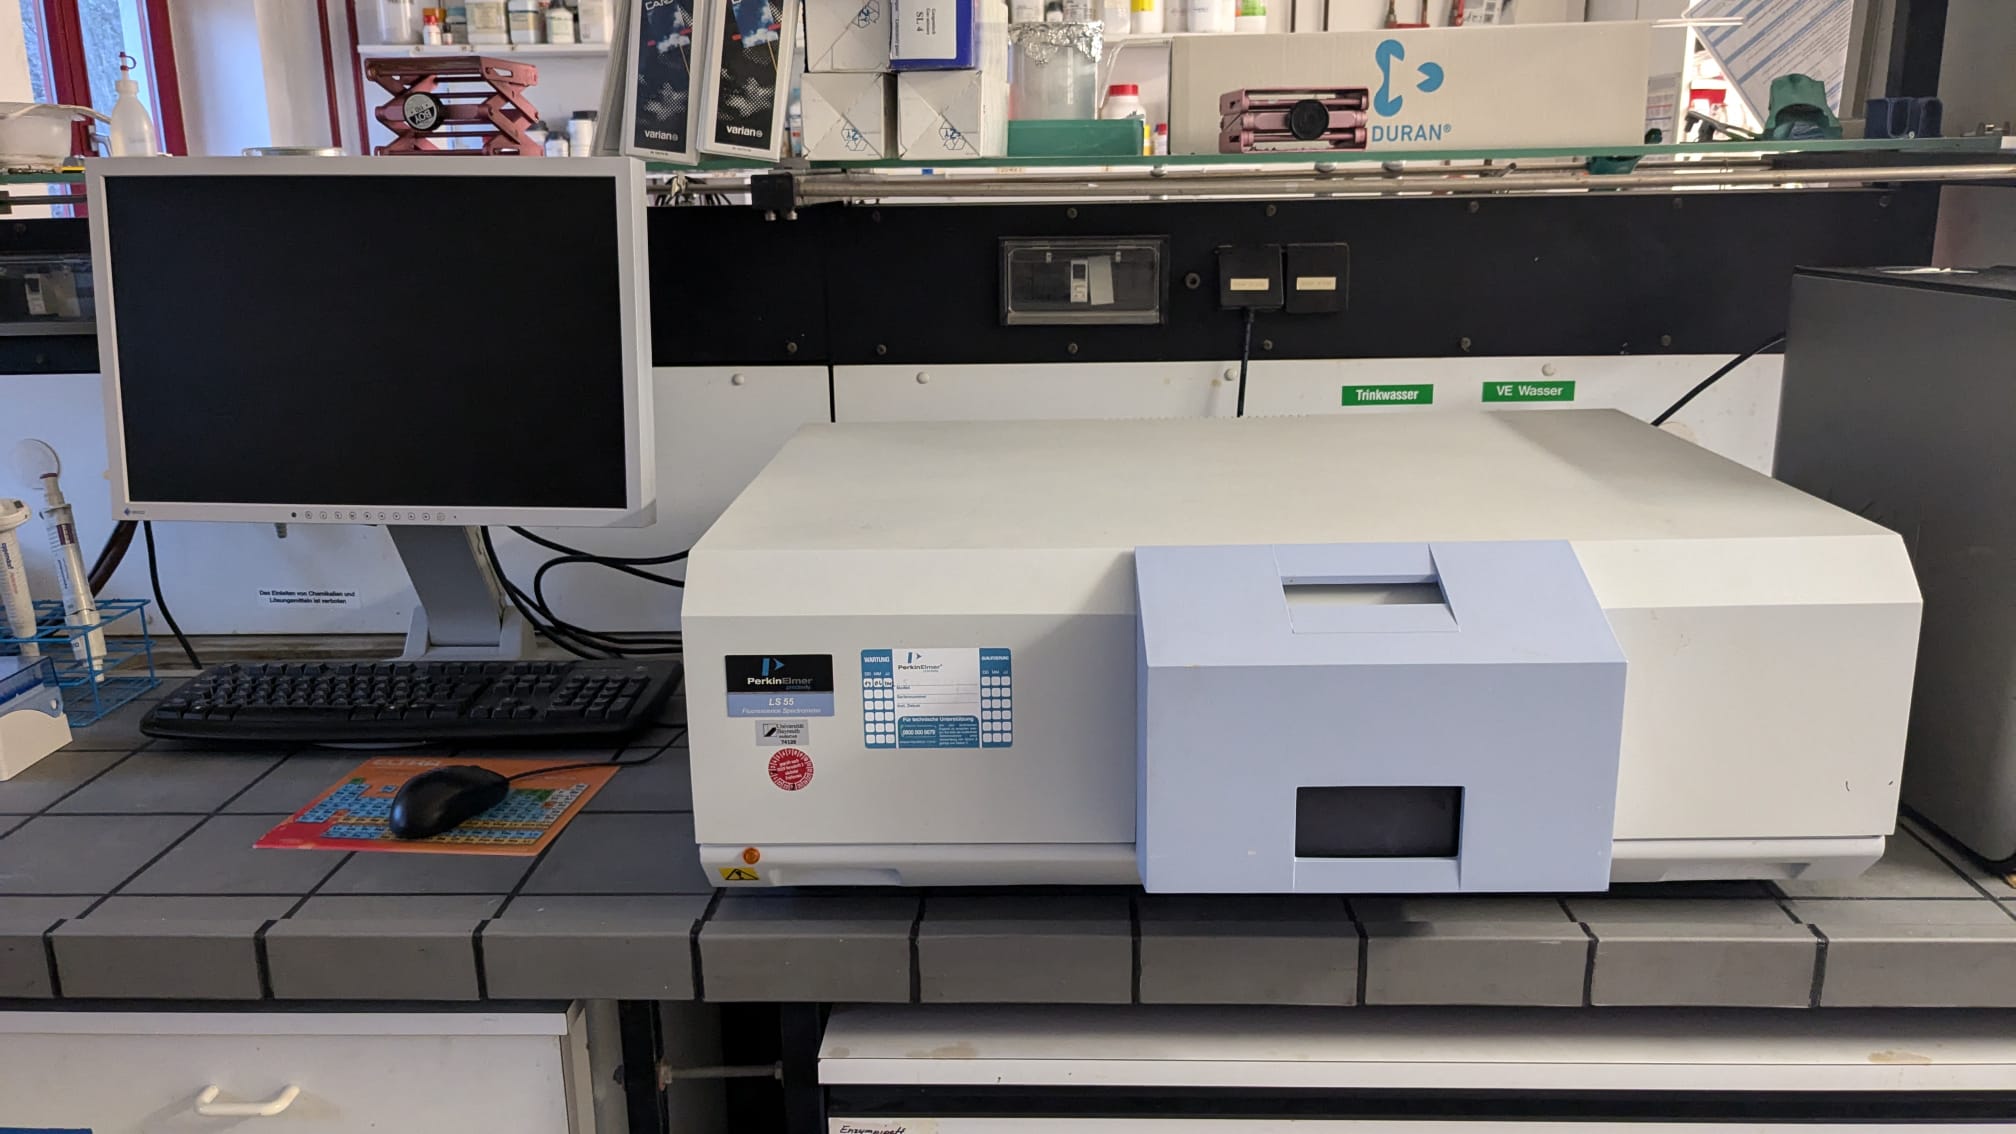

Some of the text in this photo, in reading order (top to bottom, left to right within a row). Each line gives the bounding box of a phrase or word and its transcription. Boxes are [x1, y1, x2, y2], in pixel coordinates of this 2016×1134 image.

[644, 130, 672, 141] varian
[726, 125, 756, 137] varian
[1355, 388, 1420, 401] Trinkwasser
[1496, 385, 1563, 397] VE Wasser
[746, 677, 814, 686] PerkinElmer
[768, 697, 795, 706] LS 55
